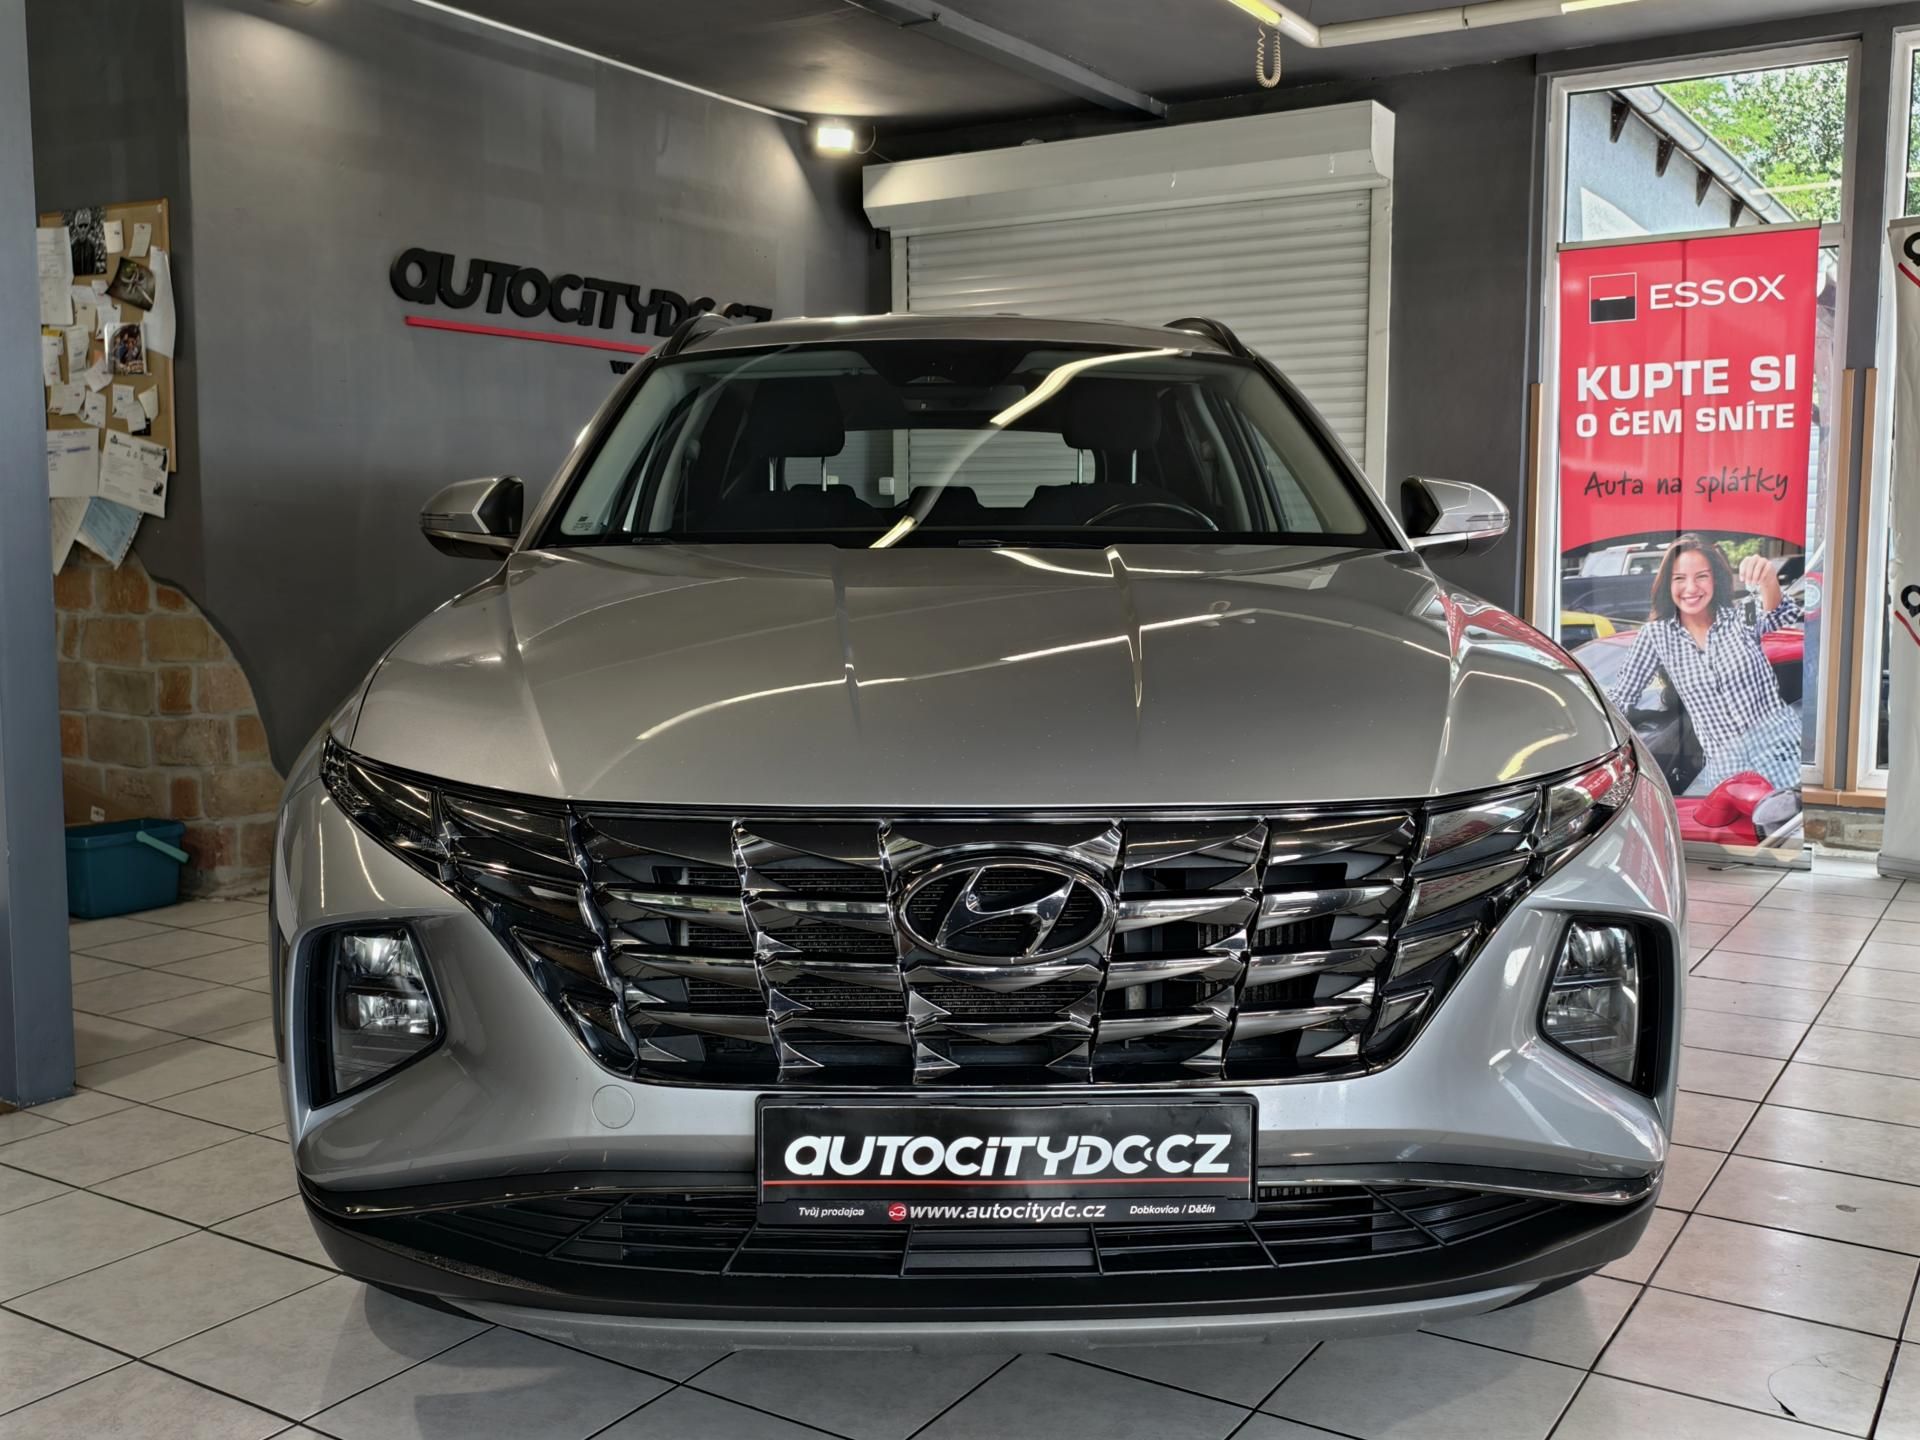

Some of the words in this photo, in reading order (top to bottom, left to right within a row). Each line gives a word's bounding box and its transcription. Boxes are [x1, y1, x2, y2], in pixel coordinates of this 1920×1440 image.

[1649, 274, 1786, 310] ESSOX
[1577, 358, 1730, 402] KUPTE
[1749, 354, 1797, 392] SI
[1576, 414, 1598, 438] O
[1609, 407, 1683, 436] ČEM
[1695, 399, 1795, 433] SNÍTE
[1584, 471, 1645, 499] Auta
[1655, 476, 1683, 495] na
[1694, 466, 1789, 503] splátky
[799, 1206, 819, 1218] Tvůj
[909, 1201, 1107, 1222] www.autocitydc.cz
[1129, 1204, 1180, 1215] Dobkovice
